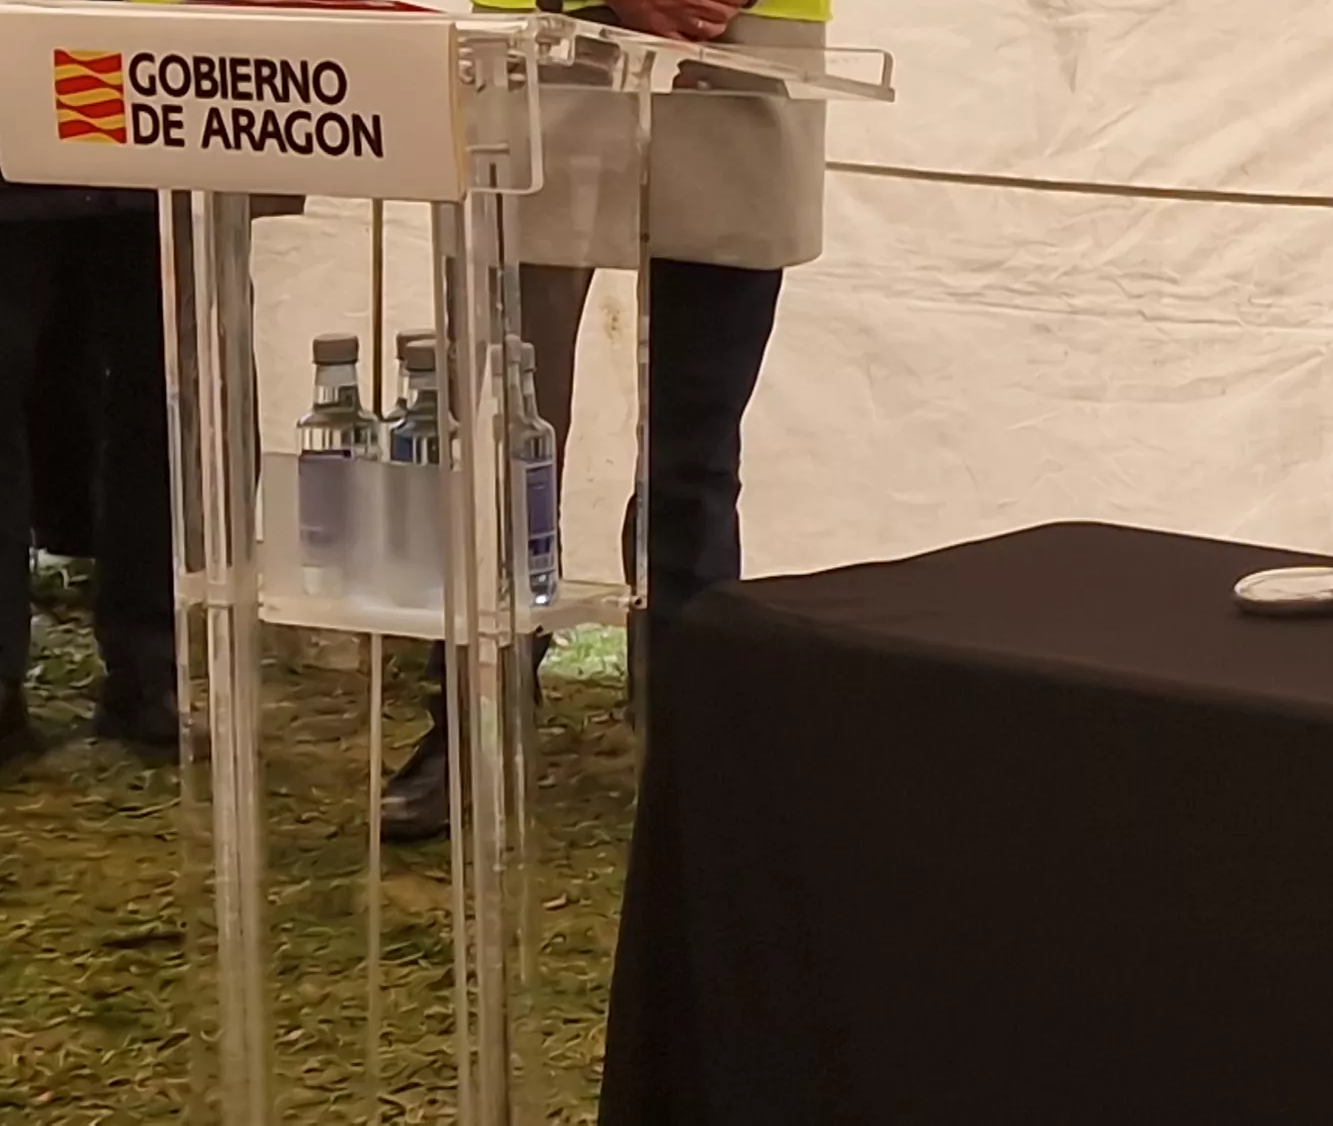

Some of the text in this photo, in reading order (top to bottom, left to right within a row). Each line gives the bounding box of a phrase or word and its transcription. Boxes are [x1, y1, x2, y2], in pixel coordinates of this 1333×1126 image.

[128, 52, 348, 105] GOBIERNO
[131, 102, 384, 158] DE ARAGON
